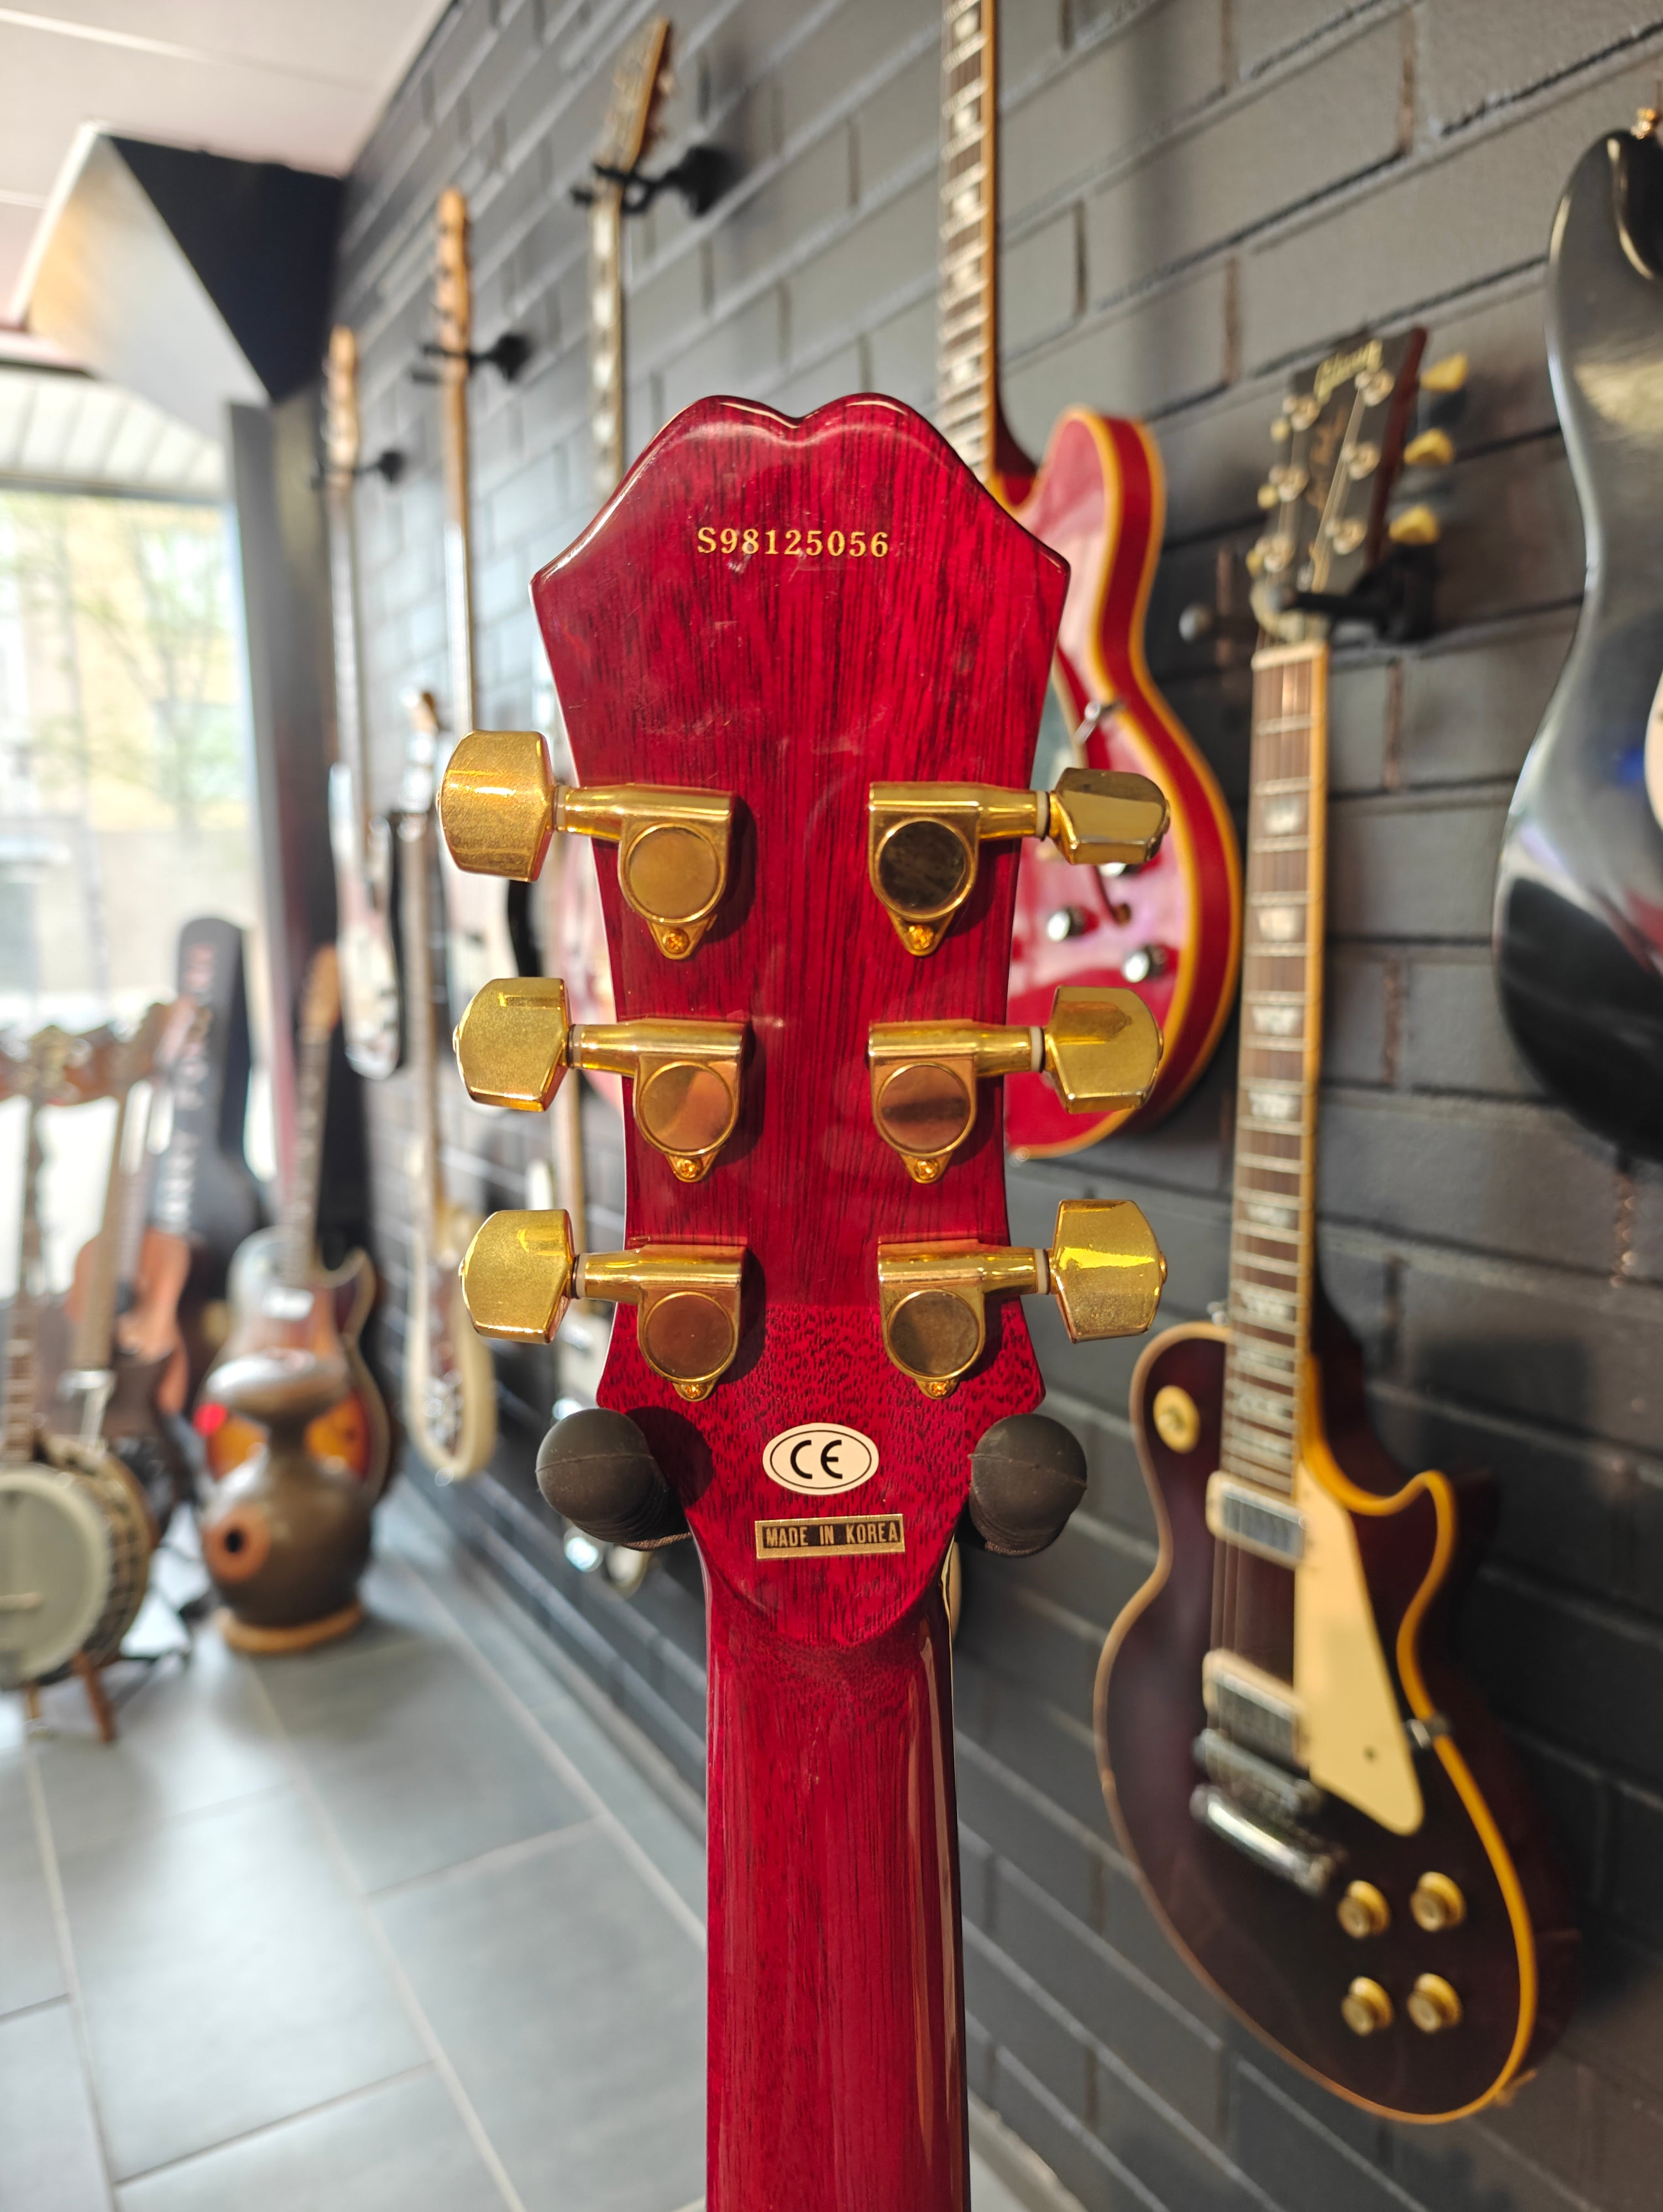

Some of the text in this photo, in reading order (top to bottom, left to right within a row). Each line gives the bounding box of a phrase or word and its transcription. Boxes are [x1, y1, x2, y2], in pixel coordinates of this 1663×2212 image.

[697, 527, 888, 557] S98125056
[791, 1439, 843, 1479] CE
[765, 1522, 899, 1547] MADE IN KOREA
